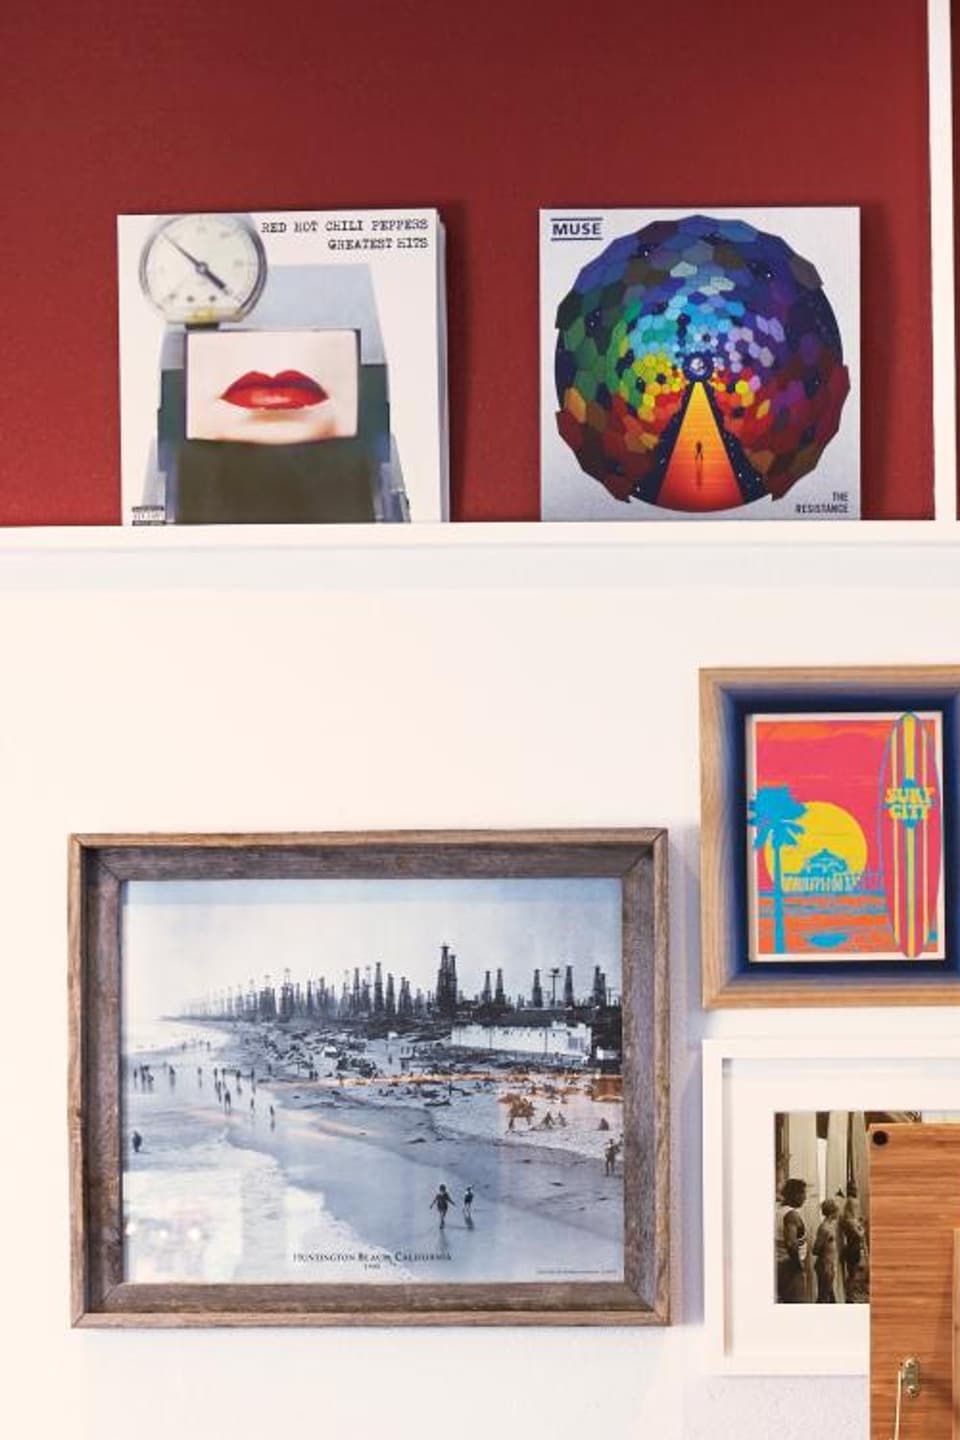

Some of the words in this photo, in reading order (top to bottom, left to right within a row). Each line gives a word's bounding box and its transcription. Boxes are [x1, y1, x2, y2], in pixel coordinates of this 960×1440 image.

[261, 222, 287, 233] RED
[294, 221, 318, 232] HOT
[325, 220, 363, 231] CHILI
[371, 218, 429, 231] PEPPERS
[552, 222, 601, 235] MUSE
[327, 238, 392, 250] GREATEST
[396, 237, 429, 248] HITS
[832, 491, 848, 501] THE
[293, 1252, 355, 1262] HUNTINGTON
